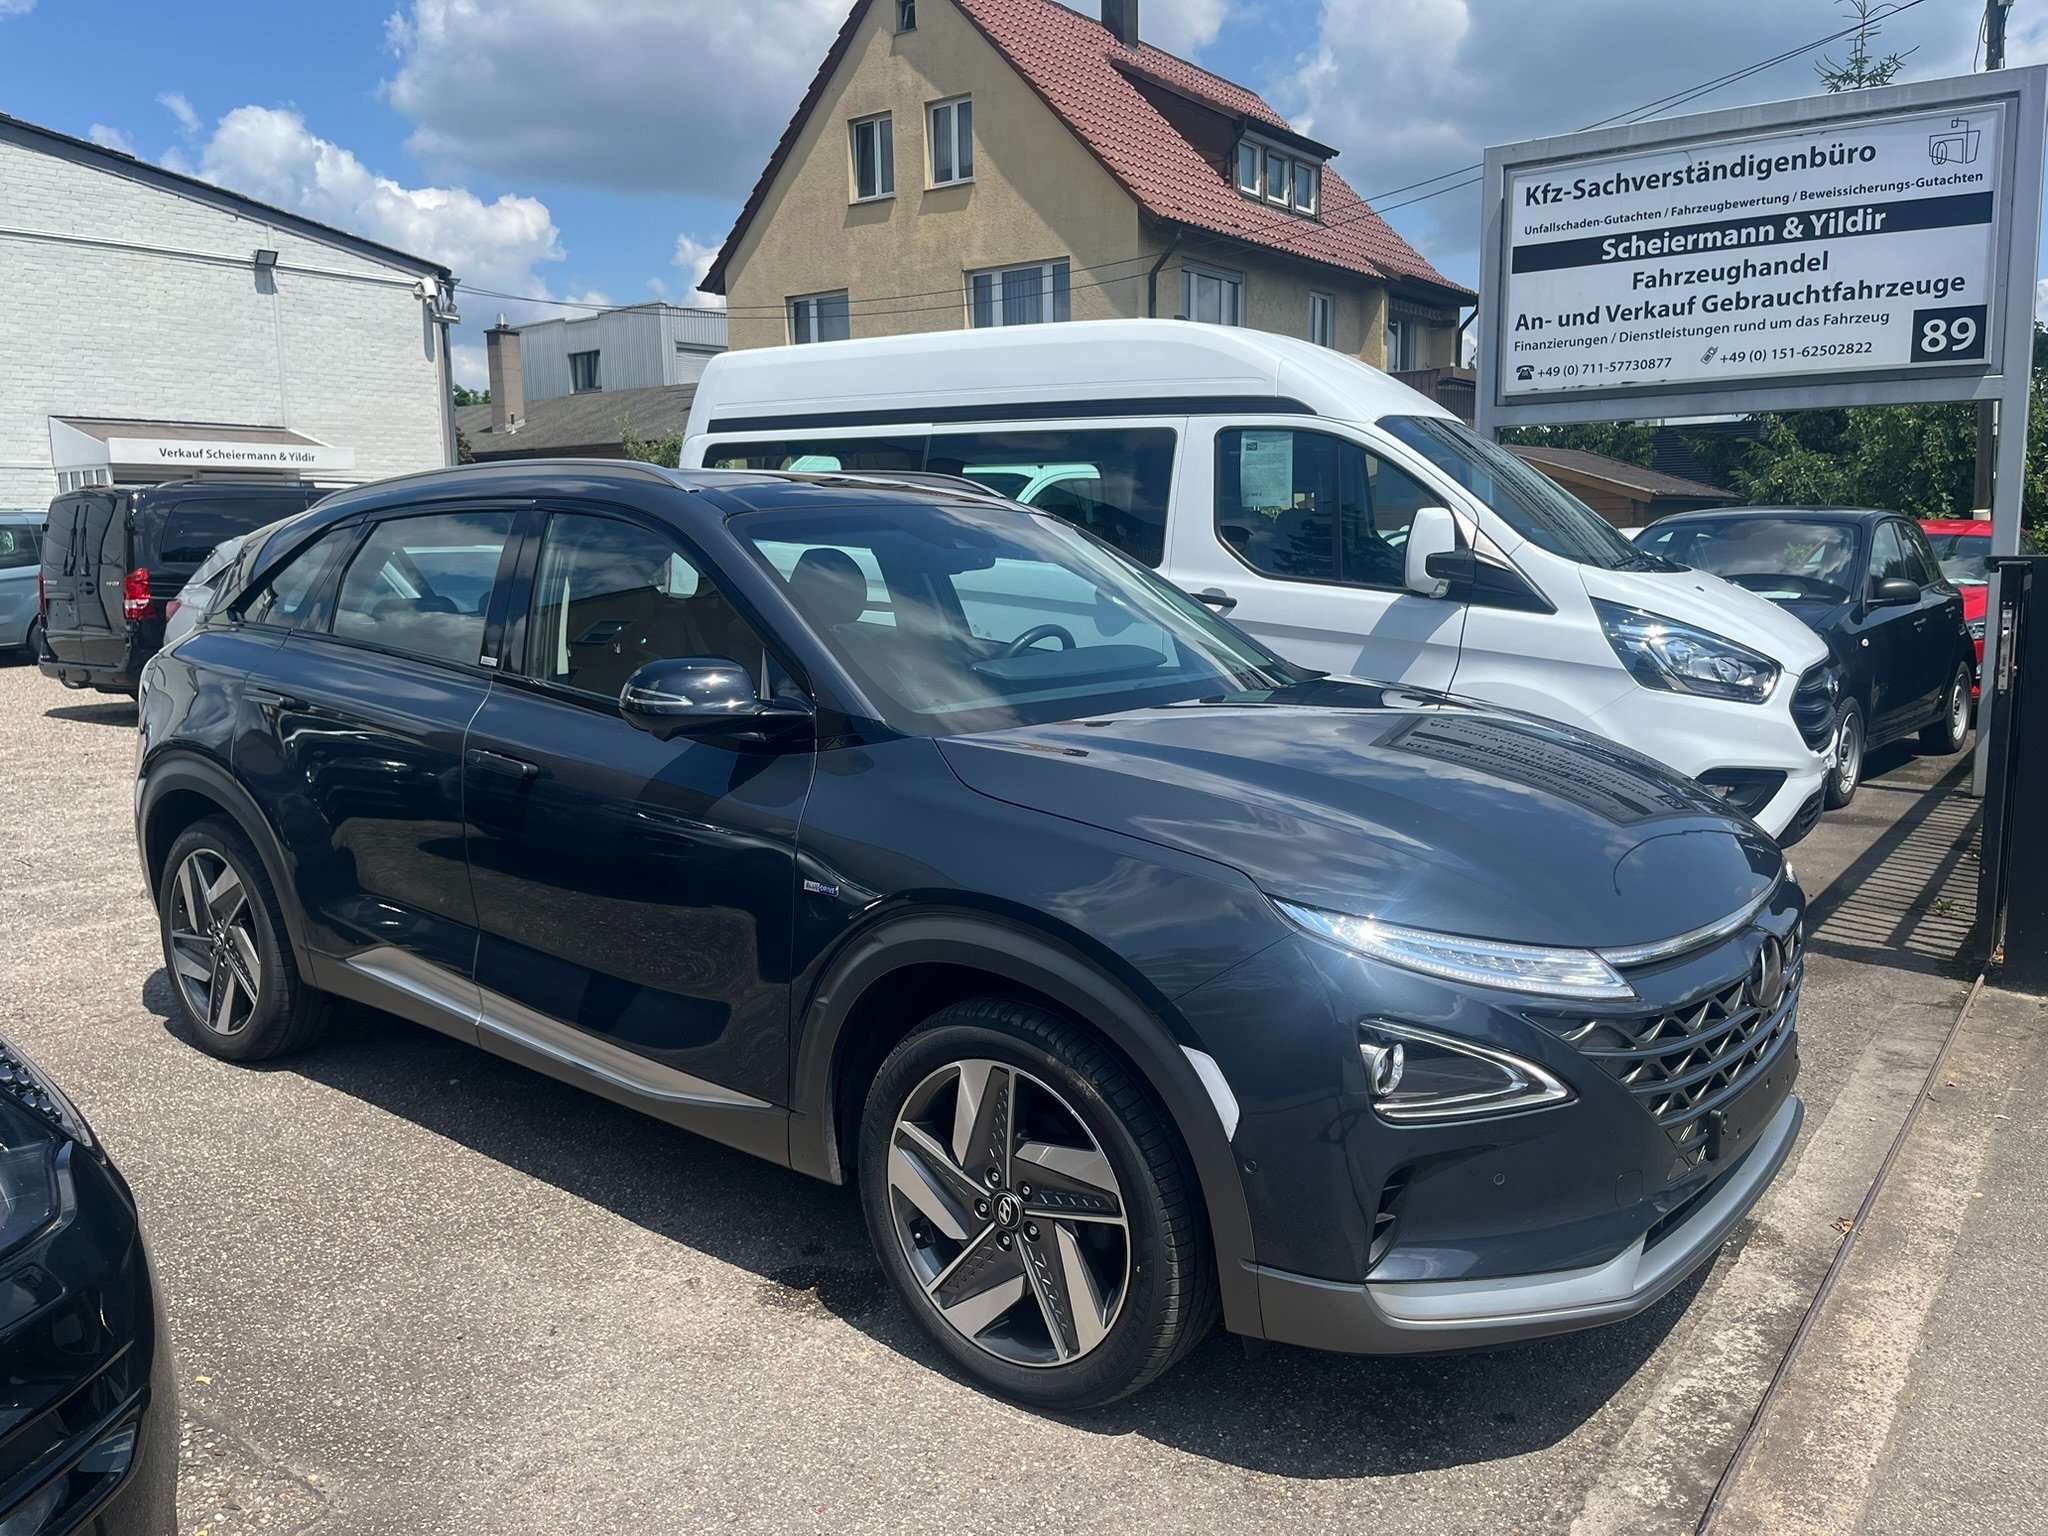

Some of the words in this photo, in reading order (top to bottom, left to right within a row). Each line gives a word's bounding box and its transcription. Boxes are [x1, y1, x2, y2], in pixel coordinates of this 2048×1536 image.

[1525, 143, 1876, 207] Kfz-Sachverständigenbüro
[1524, 210, 1662, 236] Unfallschaden-Gutachten
[1663, 207, 1670, 218] /
[1671, 194, 1790, 217] Fahrzeugbewertung
[1792, 191, 1798, 202] /
[1800, 172, 1984, 201] Beweissicherungs-Gutachten
[1601, 223, 1775, 260] Scheiermann
[1782, 216, 1804, 240] &
[1809, 208, 1887, 237] Yildir
[1632, 250, 1829, 290] Fahrzeughandel
[1514, 313, 1552, 332] An-
[1558, 306, 1600, 328] und
[1605, 295, 1697, 323] Verkauf
[1701, 275, 1966, 314] Gebrauchtfahrzeuge
[1514, 335, 1608, 352] Finanzierungen
[1610, 332, 1616, 344] /
[1619, 322, 1730, 343] Dienstleistungen
[1733, 319, 1766, 332] rund
[1770, 318, 1792, 330] um
[1796, 315, 1820, 328] das
[1823, 312, 1890, 326] Fahrzeug
[1920, 316, 1977, 353] 89
[1537, 366, 1560, 378] +49
[1563, 365, 1579, 377] (0)
[1582, 357, 1673, 375] 711-57730877
[1720, 351, 1746, 364] +49
[1749, 349, 1767, 363] (0)
[1771, 341, 1873, 360] 151-62502822
[159, 447, 203, 459] Verkauf
[206, 449, 277, 461] Scheiermann
[279, 452, 287, 461] &
[288, 452, 316, 463] Yildir
